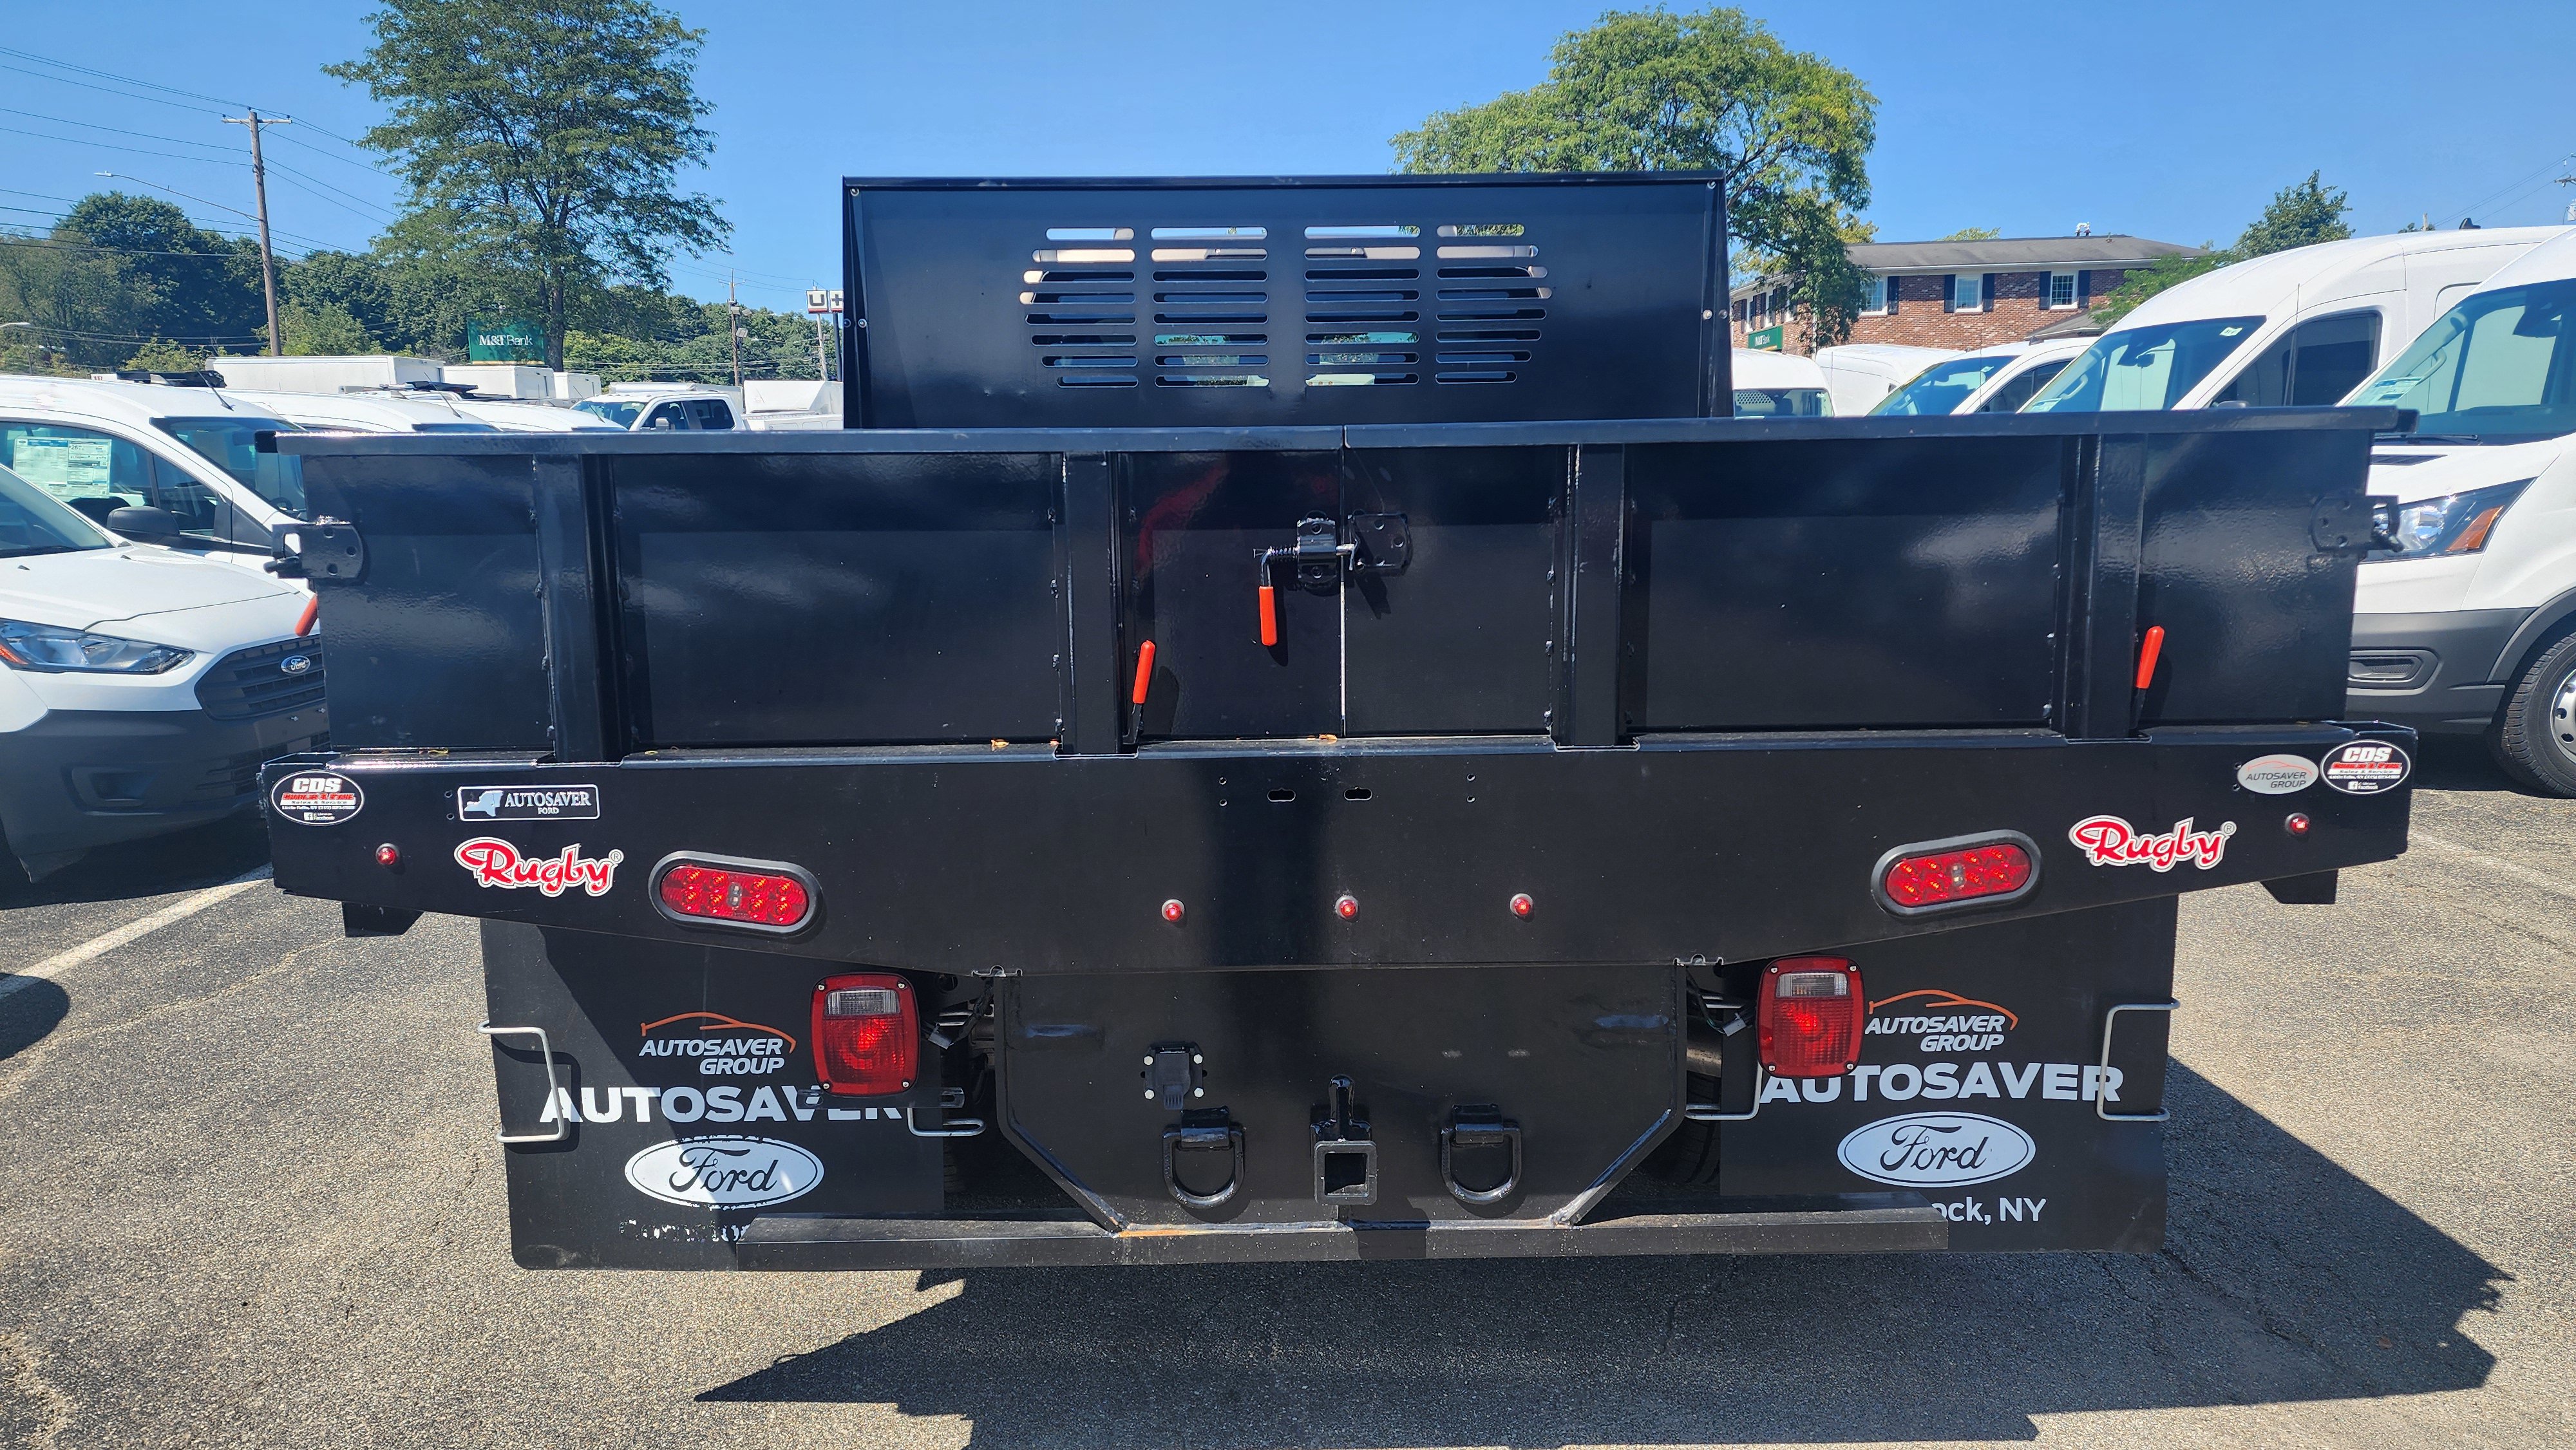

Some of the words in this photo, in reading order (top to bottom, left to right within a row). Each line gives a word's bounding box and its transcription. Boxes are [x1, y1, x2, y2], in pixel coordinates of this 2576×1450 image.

[478, 334, 506, 346] M&T
[507, 334, 533, 346] Bank
[290, 658, 308, 671] Ford
[2342, 747, 2392, 762] CDS
[292, 777, 343, 793] CDS
[2246, 771, 2307, 781] AUTOSAVER
[2271, 780, 2306, 788] GROUP
[504, 791, 592, 807] AUTOSAVER
[2070, 816, 2226, 869] Rugby
[456, 838, 616, 896] Rugby
[1864, 1015, 2005, 1035] AUTOSAVER
[638, 1038, 784, 1057] AUTOSAVER
[1920, 1034, 2005, 1052] GROUP
[699, 1057, 785, 1075] GROUP
[1759, 1062, 2124, 1104] AUTOSAVER
[1879, 1124, 1989, 1171] Ford
[668, 1146, 779, 1192] Ford
[1999, 1197, 2047, 1221] NY
